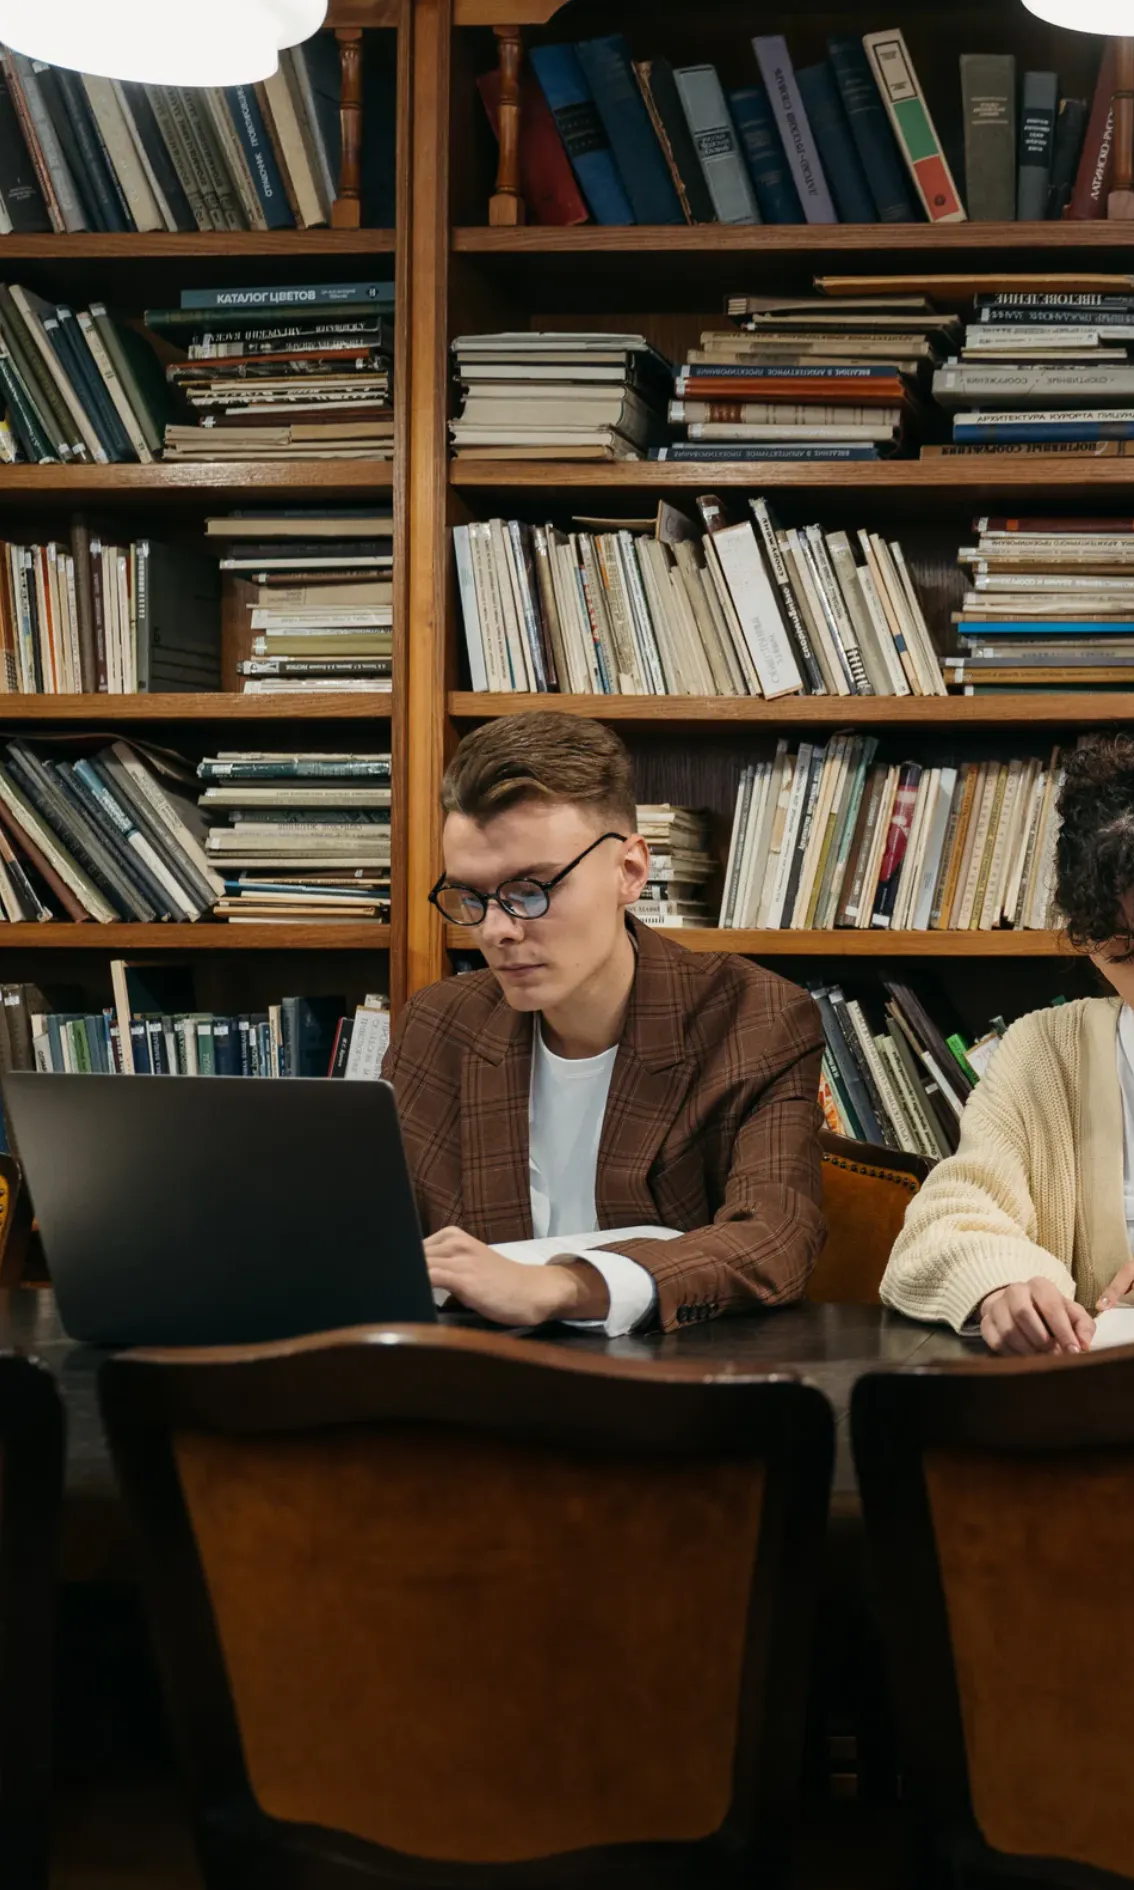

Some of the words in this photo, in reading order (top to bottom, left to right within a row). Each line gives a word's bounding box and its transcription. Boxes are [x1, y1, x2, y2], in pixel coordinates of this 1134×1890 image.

[216, 292, 267, 303] КАТАЛОГ
[269, 290, 315, 303] ЦВЕТОВ
[994, 293, 1101, 306] ЦВЕТОВЕДЕНИЕ
